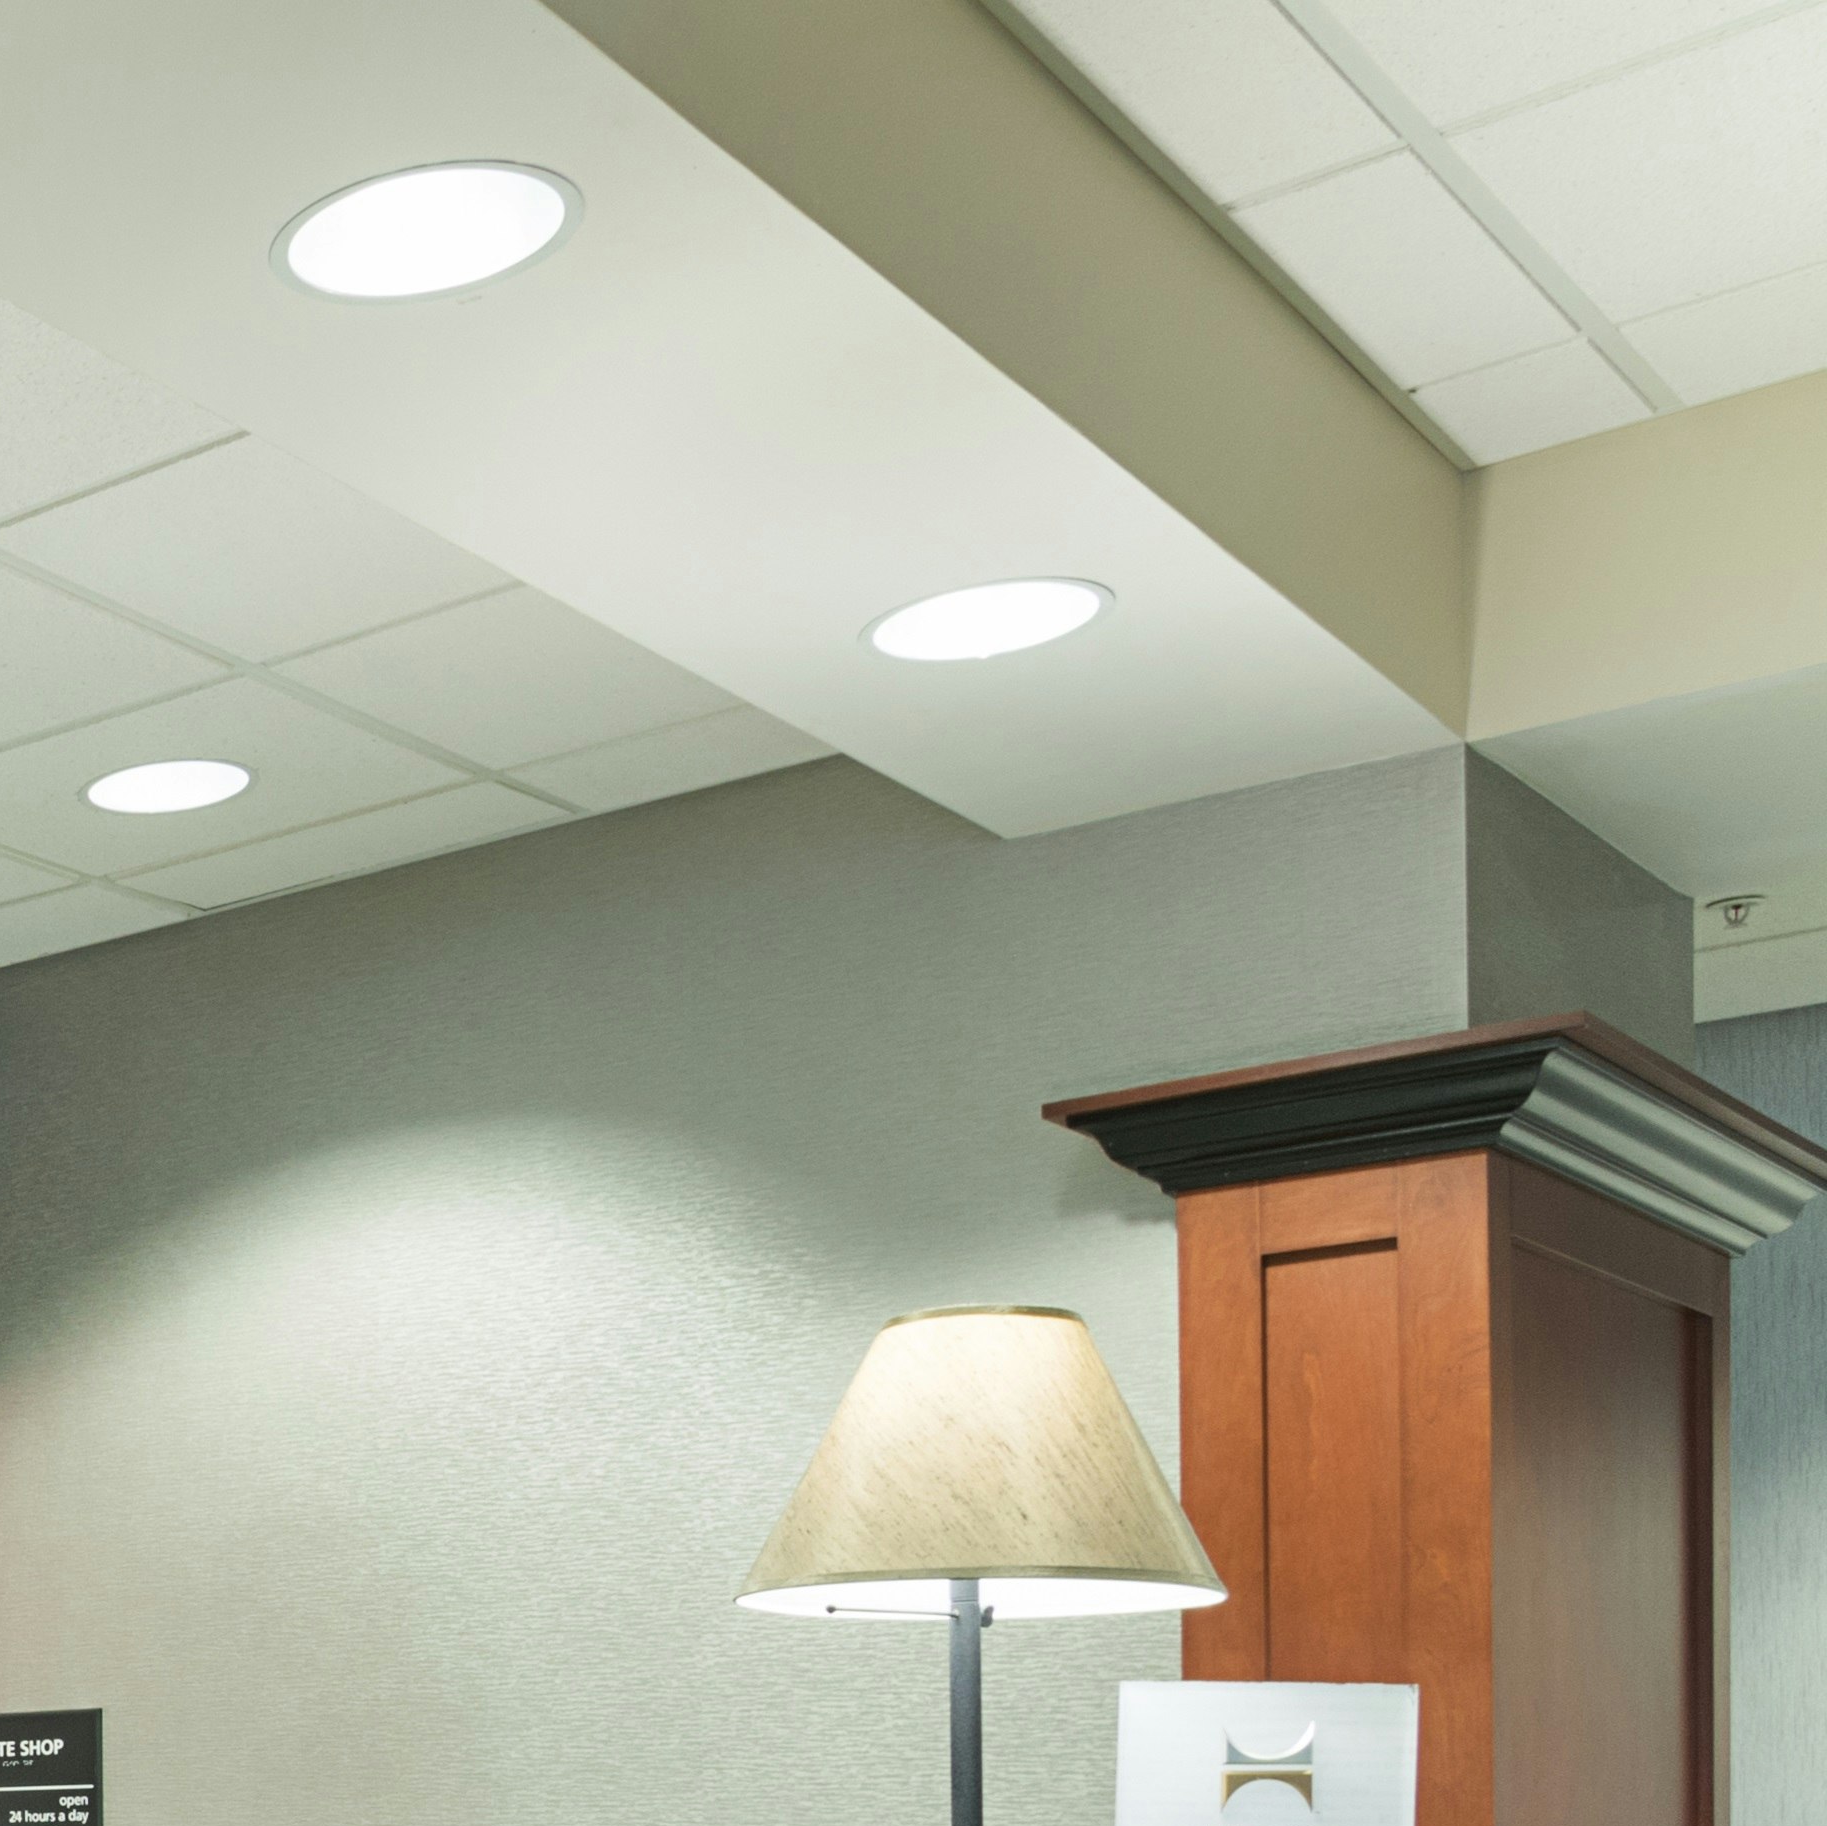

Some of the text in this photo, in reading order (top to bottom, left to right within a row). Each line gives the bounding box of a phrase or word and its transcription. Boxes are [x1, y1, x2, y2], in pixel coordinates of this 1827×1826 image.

[19, 1738, 64, 1757] SHOP
[59, 1795, 89, 1809] open
[9, 1809, 89, 1825] 24 hours a day
